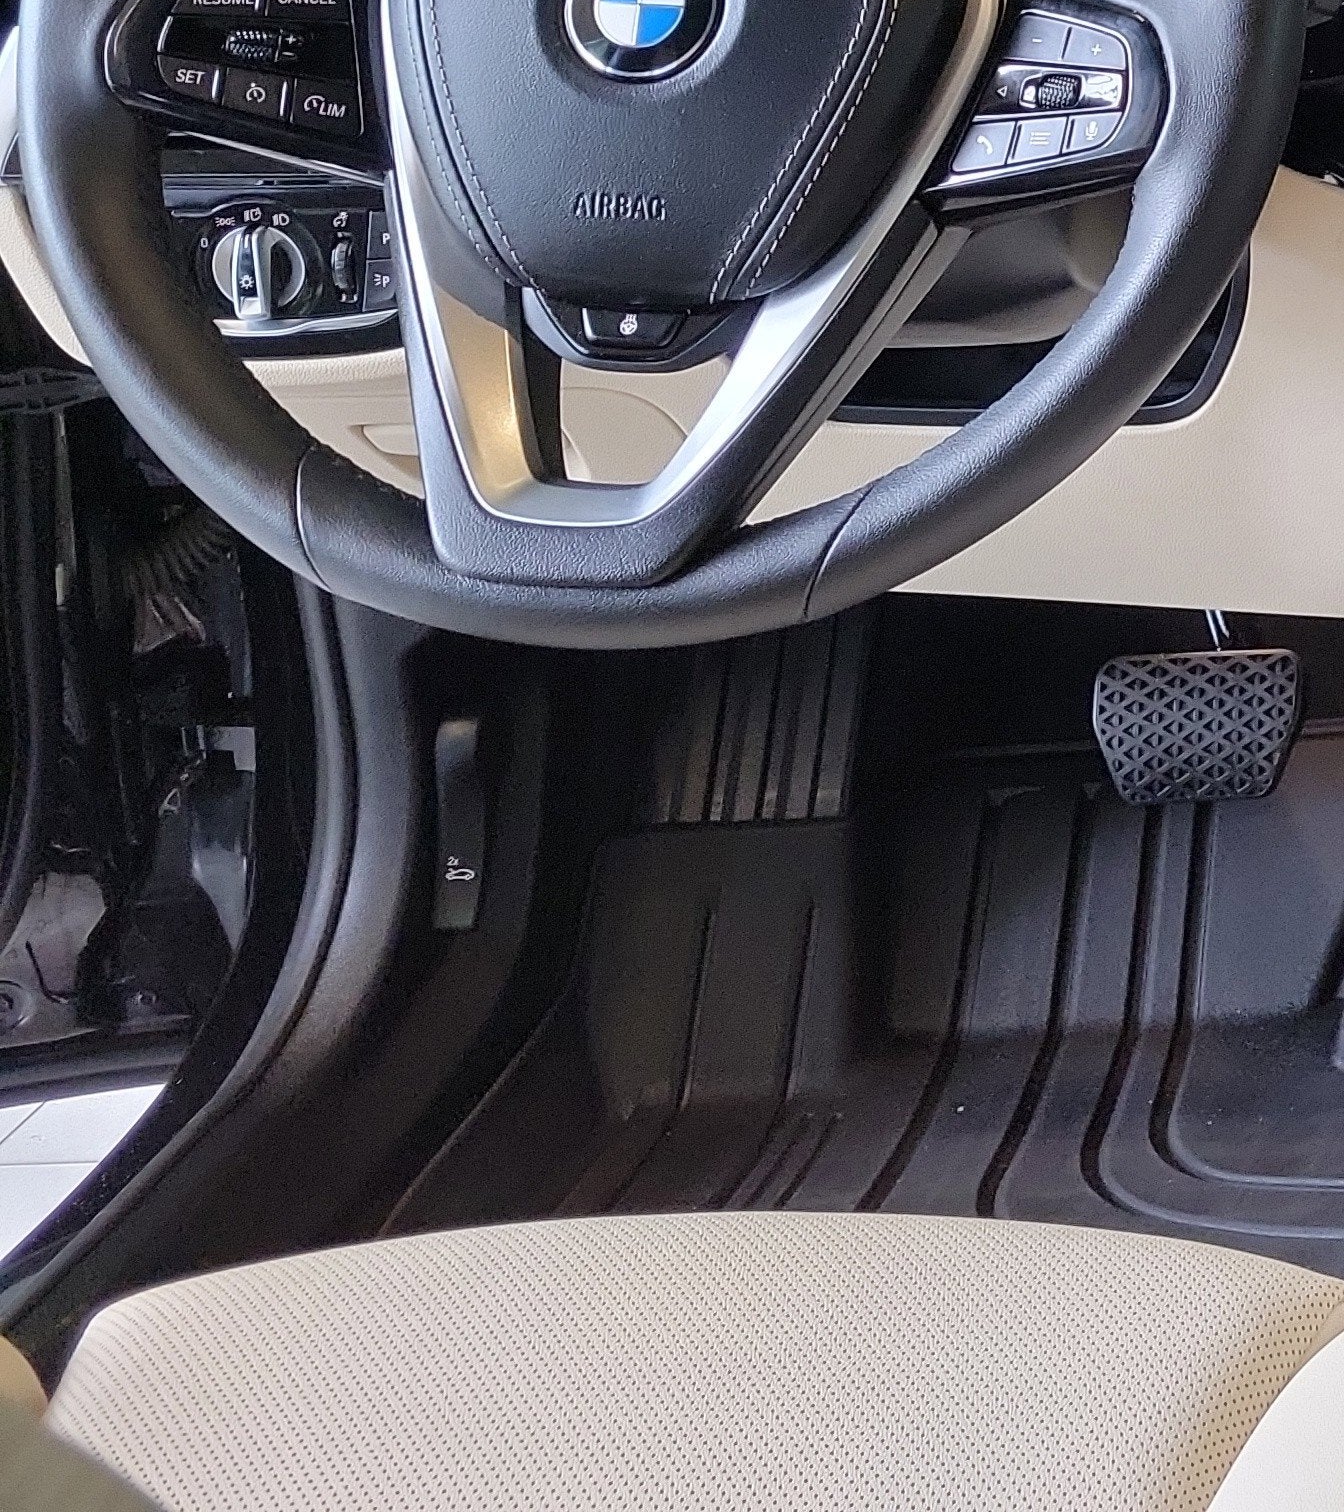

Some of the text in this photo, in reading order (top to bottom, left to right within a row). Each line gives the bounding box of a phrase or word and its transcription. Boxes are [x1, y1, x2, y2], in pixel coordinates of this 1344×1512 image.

[175, 69, 203, 85] SET
[319, 101, 346, 118] LIM
[572, 191, 667, 222] AIRBAG
